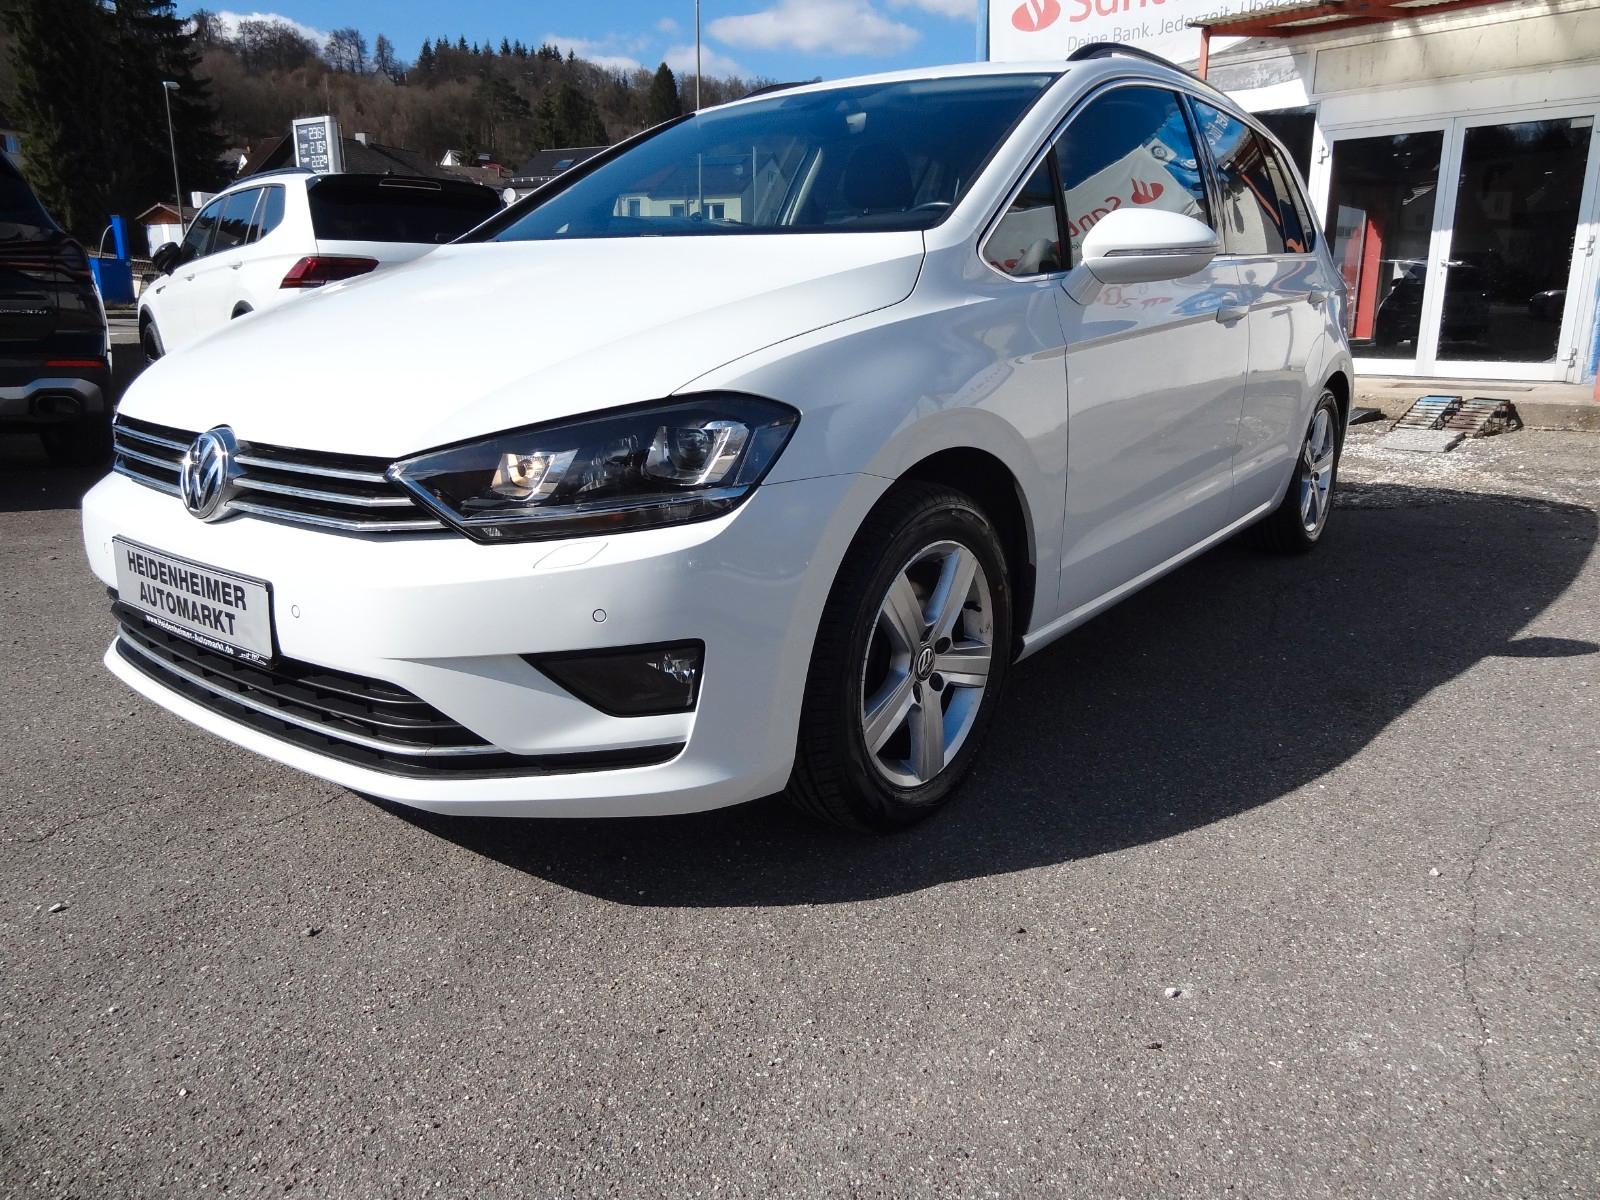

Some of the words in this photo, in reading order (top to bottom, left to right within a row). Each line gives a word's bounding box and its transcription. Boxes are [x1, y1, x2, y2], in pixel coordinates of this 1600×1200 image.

[1113, 22, 1154, 43] Bank.
[127, 550, 247, 611] HEIDENHEIMER
[140, 581, 236, 636] AUTOMARKT
